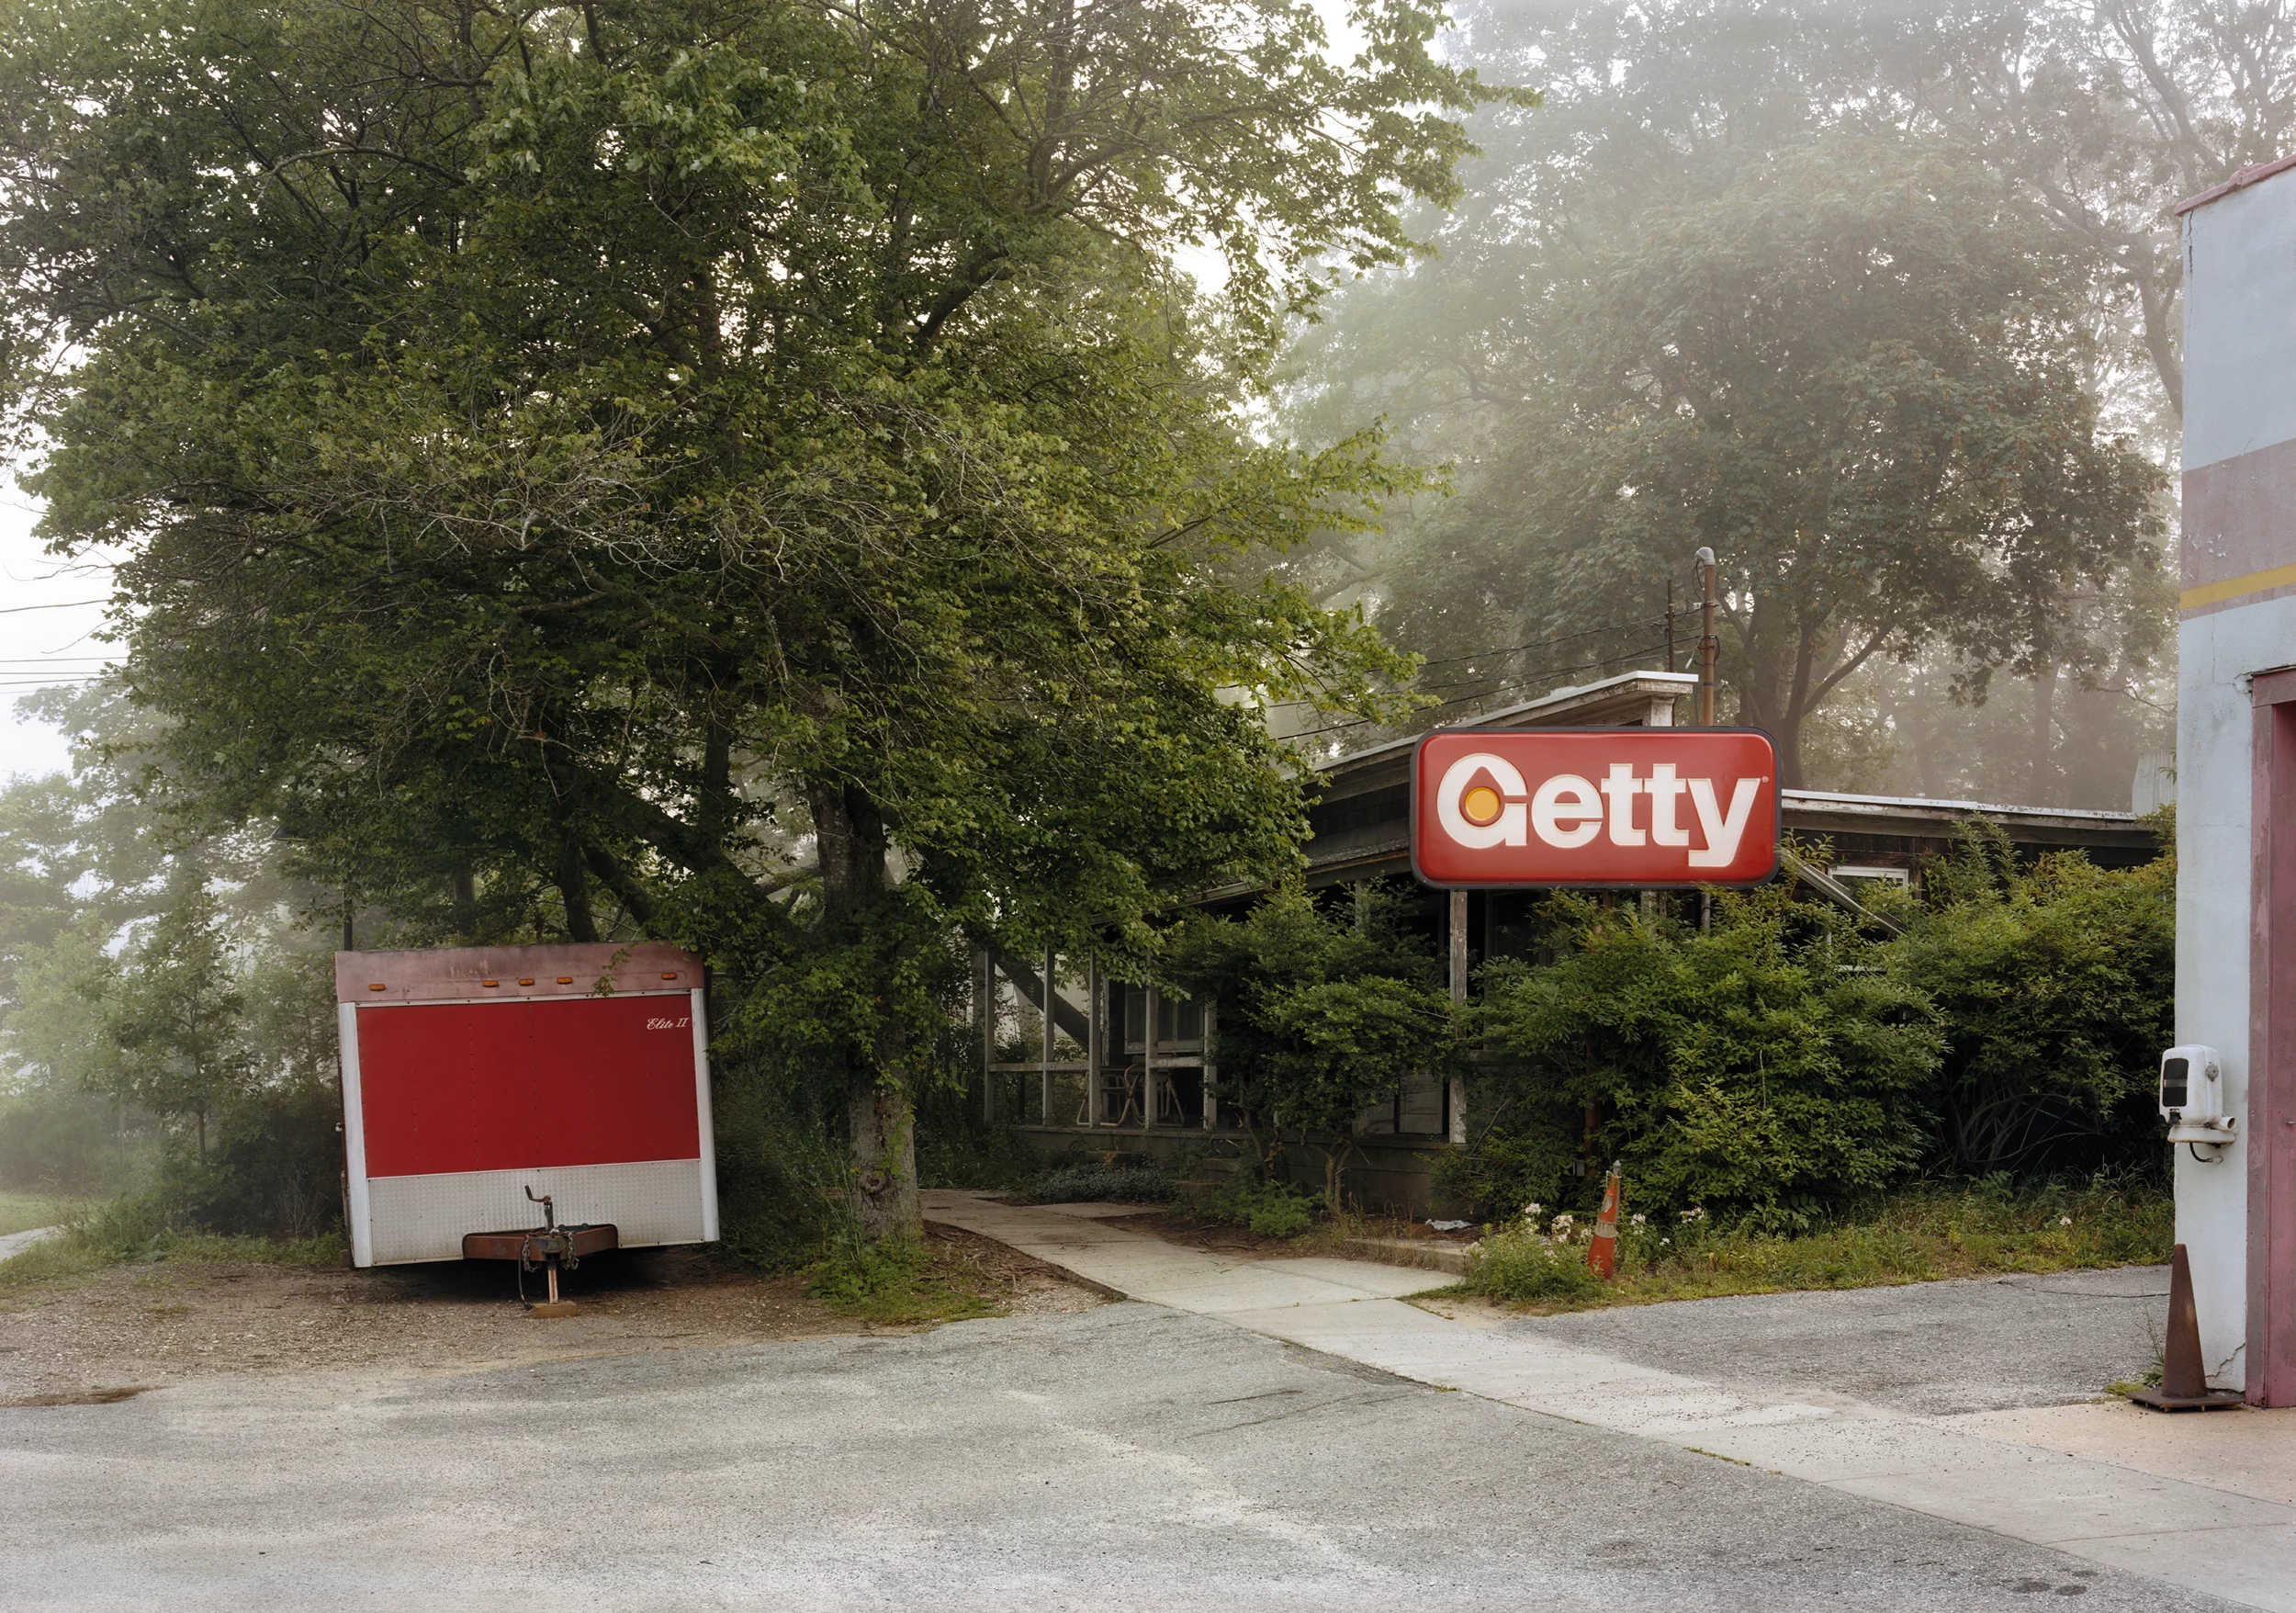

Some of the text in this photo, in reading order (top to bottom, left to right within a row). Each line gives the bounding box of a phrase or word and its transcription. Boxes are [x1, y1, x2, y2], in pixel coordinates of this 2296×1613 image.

[1436, 752, 1761, 867] Getty
[647, 1017, 690, 1030] Elite II
